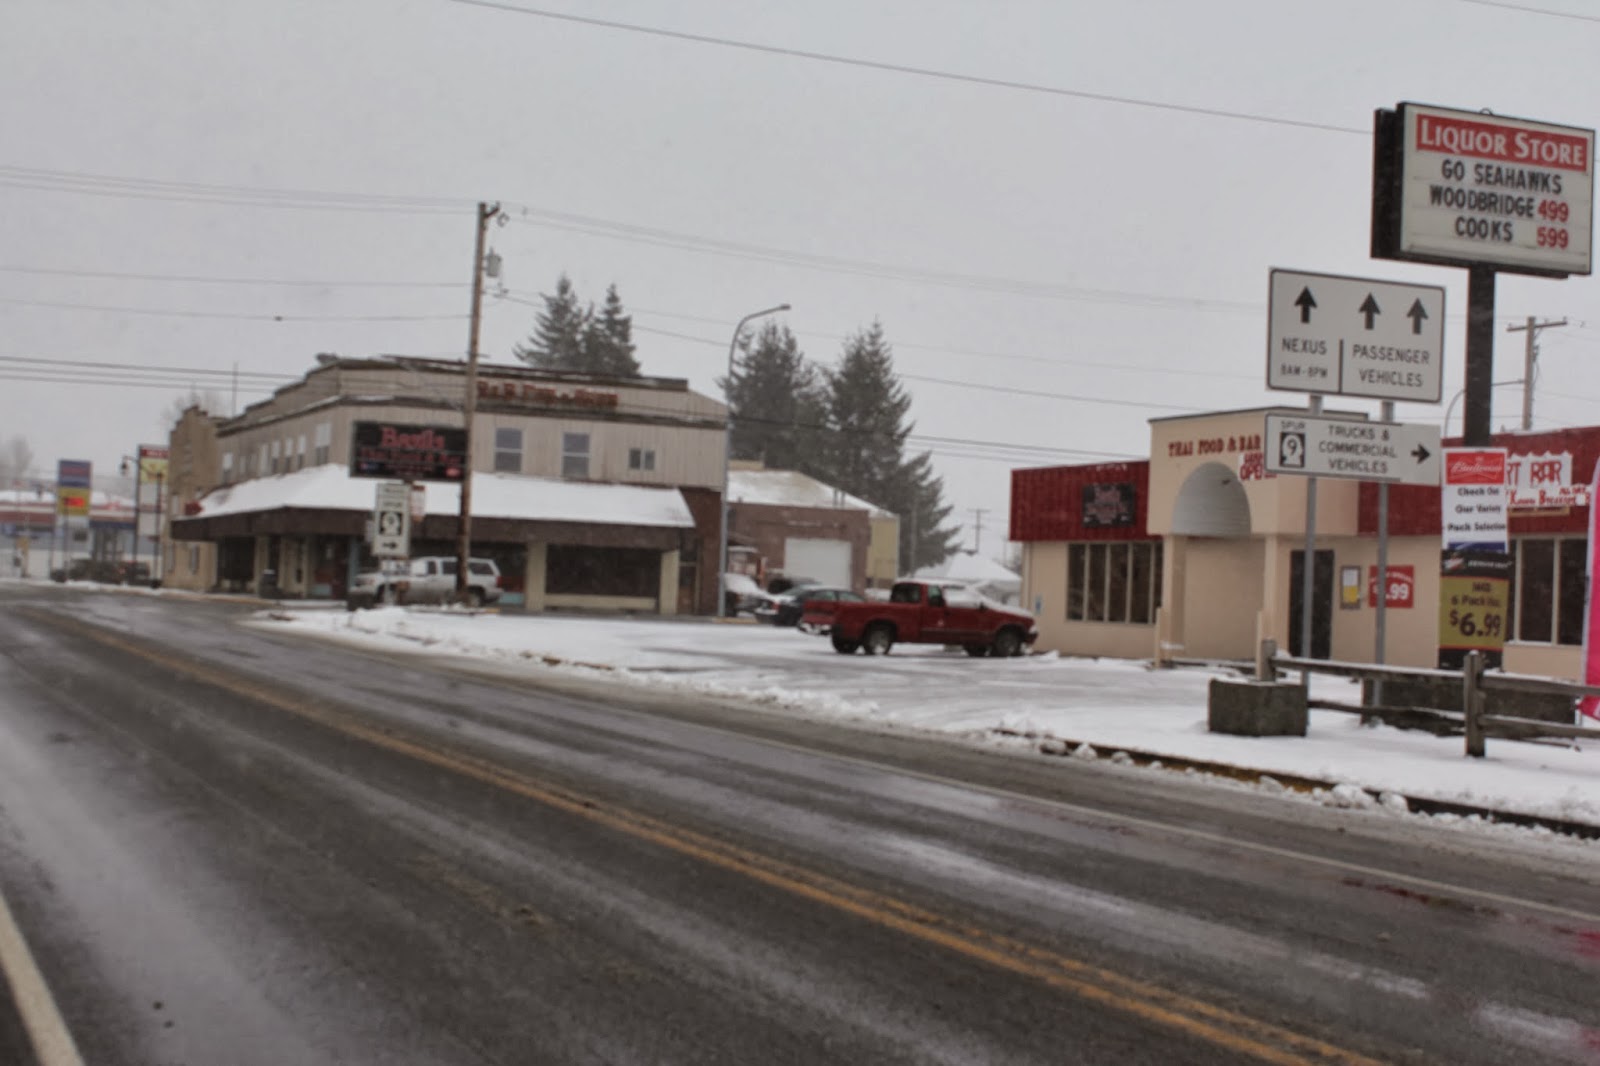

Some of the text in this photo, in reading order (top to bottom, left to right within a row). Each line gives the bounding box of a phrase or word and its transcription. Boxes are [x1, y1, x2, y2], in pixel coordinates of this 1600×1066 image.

[1420, 118, 1585, 166] LIQUOR STORE
[1441, 159, 1562, 195] GO SEAHAWKS
[1429, 185, 1569, 223] WOODBRIDGE 499
[1455, 216, 1569, 250] COOKS 599
[1281, 337, 1328, 355] NEXUS
[1352, 343, 1431, 365] PASSENGER
[1359, 368, 1423, 387] VEHICLES
[1327, 424, 1391, 440] TRUCKS &
[1168, 434, 1261, 457] THAI FOOD & BAR
[1286, 438, 1298, 456] 9
[1318, 440, 1398, 458] COMMERCIAL
[1328, 458, 1389, 474] VEHICLES
[1449, 609, 1501, 638] $6.99
